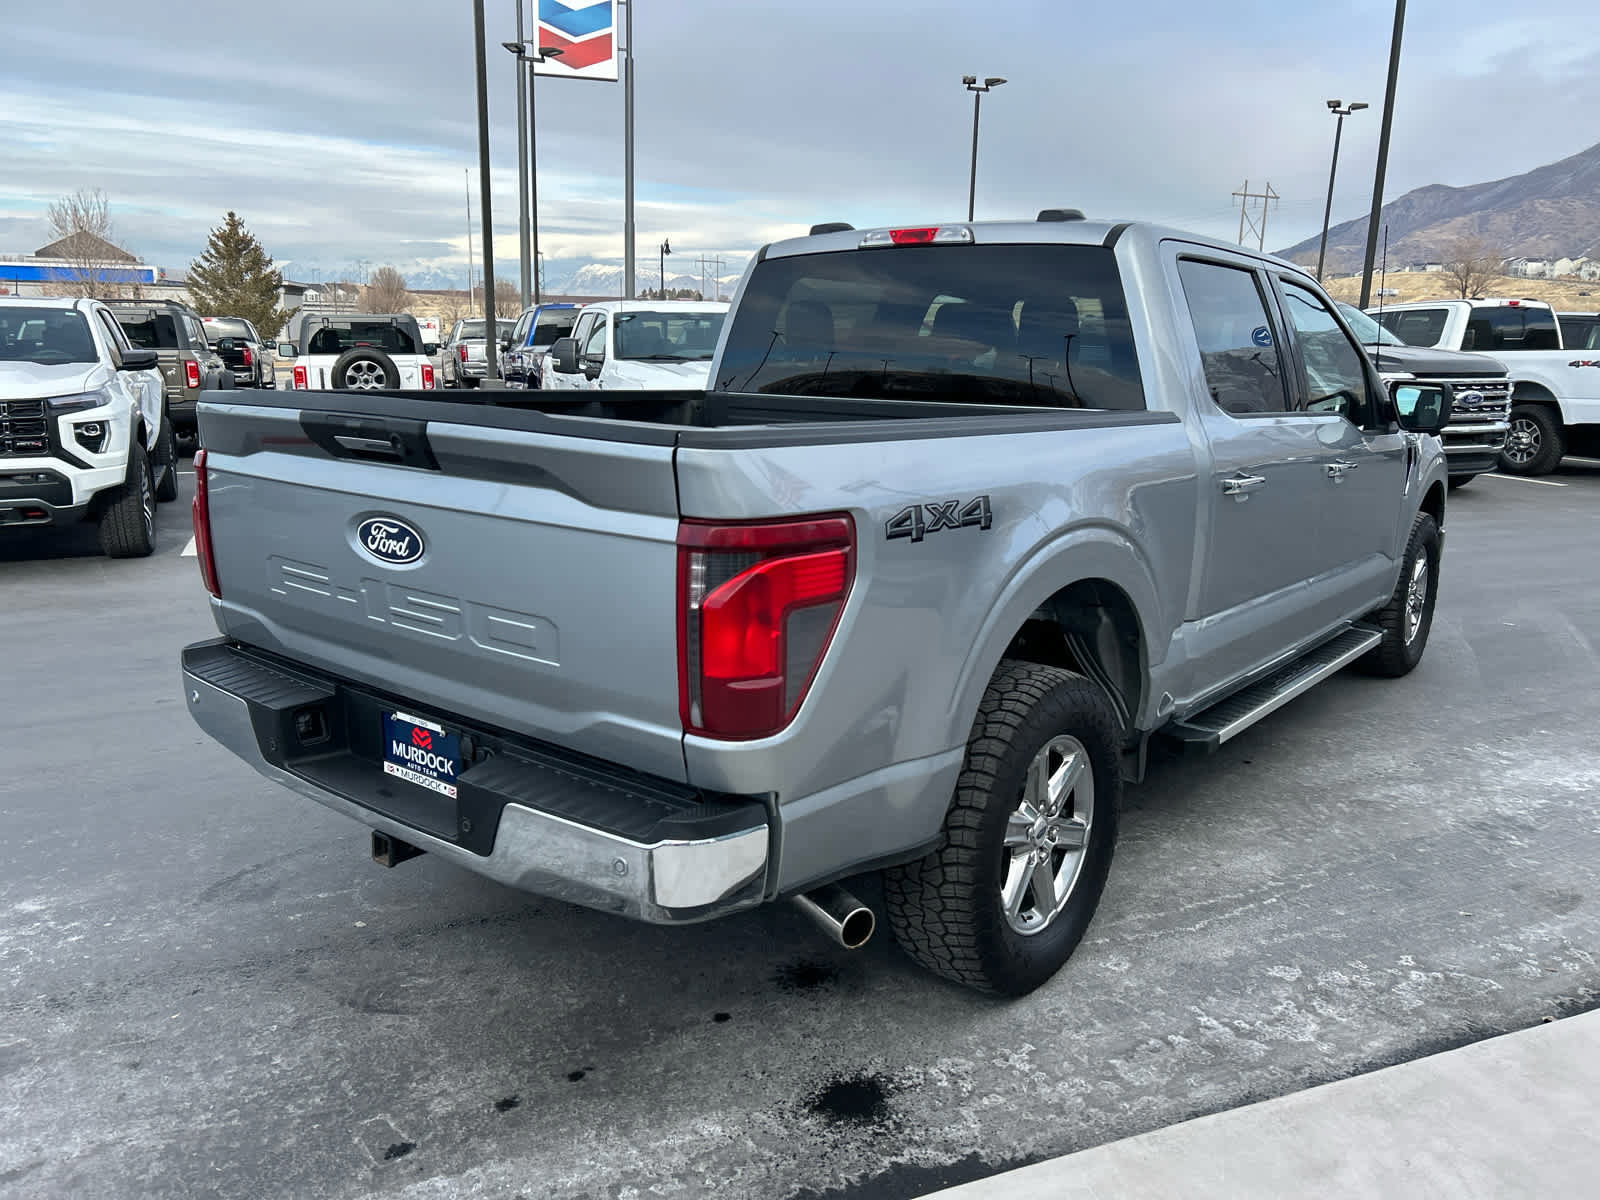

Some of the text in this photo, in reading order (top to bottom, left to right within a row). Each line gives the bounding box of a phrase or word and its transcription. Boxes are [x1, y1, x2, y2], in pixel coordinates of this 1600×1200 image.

[885, 495, 992, 543] 4X4
[367, 522, 411, 558] Ford
[266, 554, 560, 667] F-150
[393, 740, 454, 776] MURDOCK
[407, 762, 438, 777] AUTO TEAM
[400, 770, 442, 790] MURDOCK
